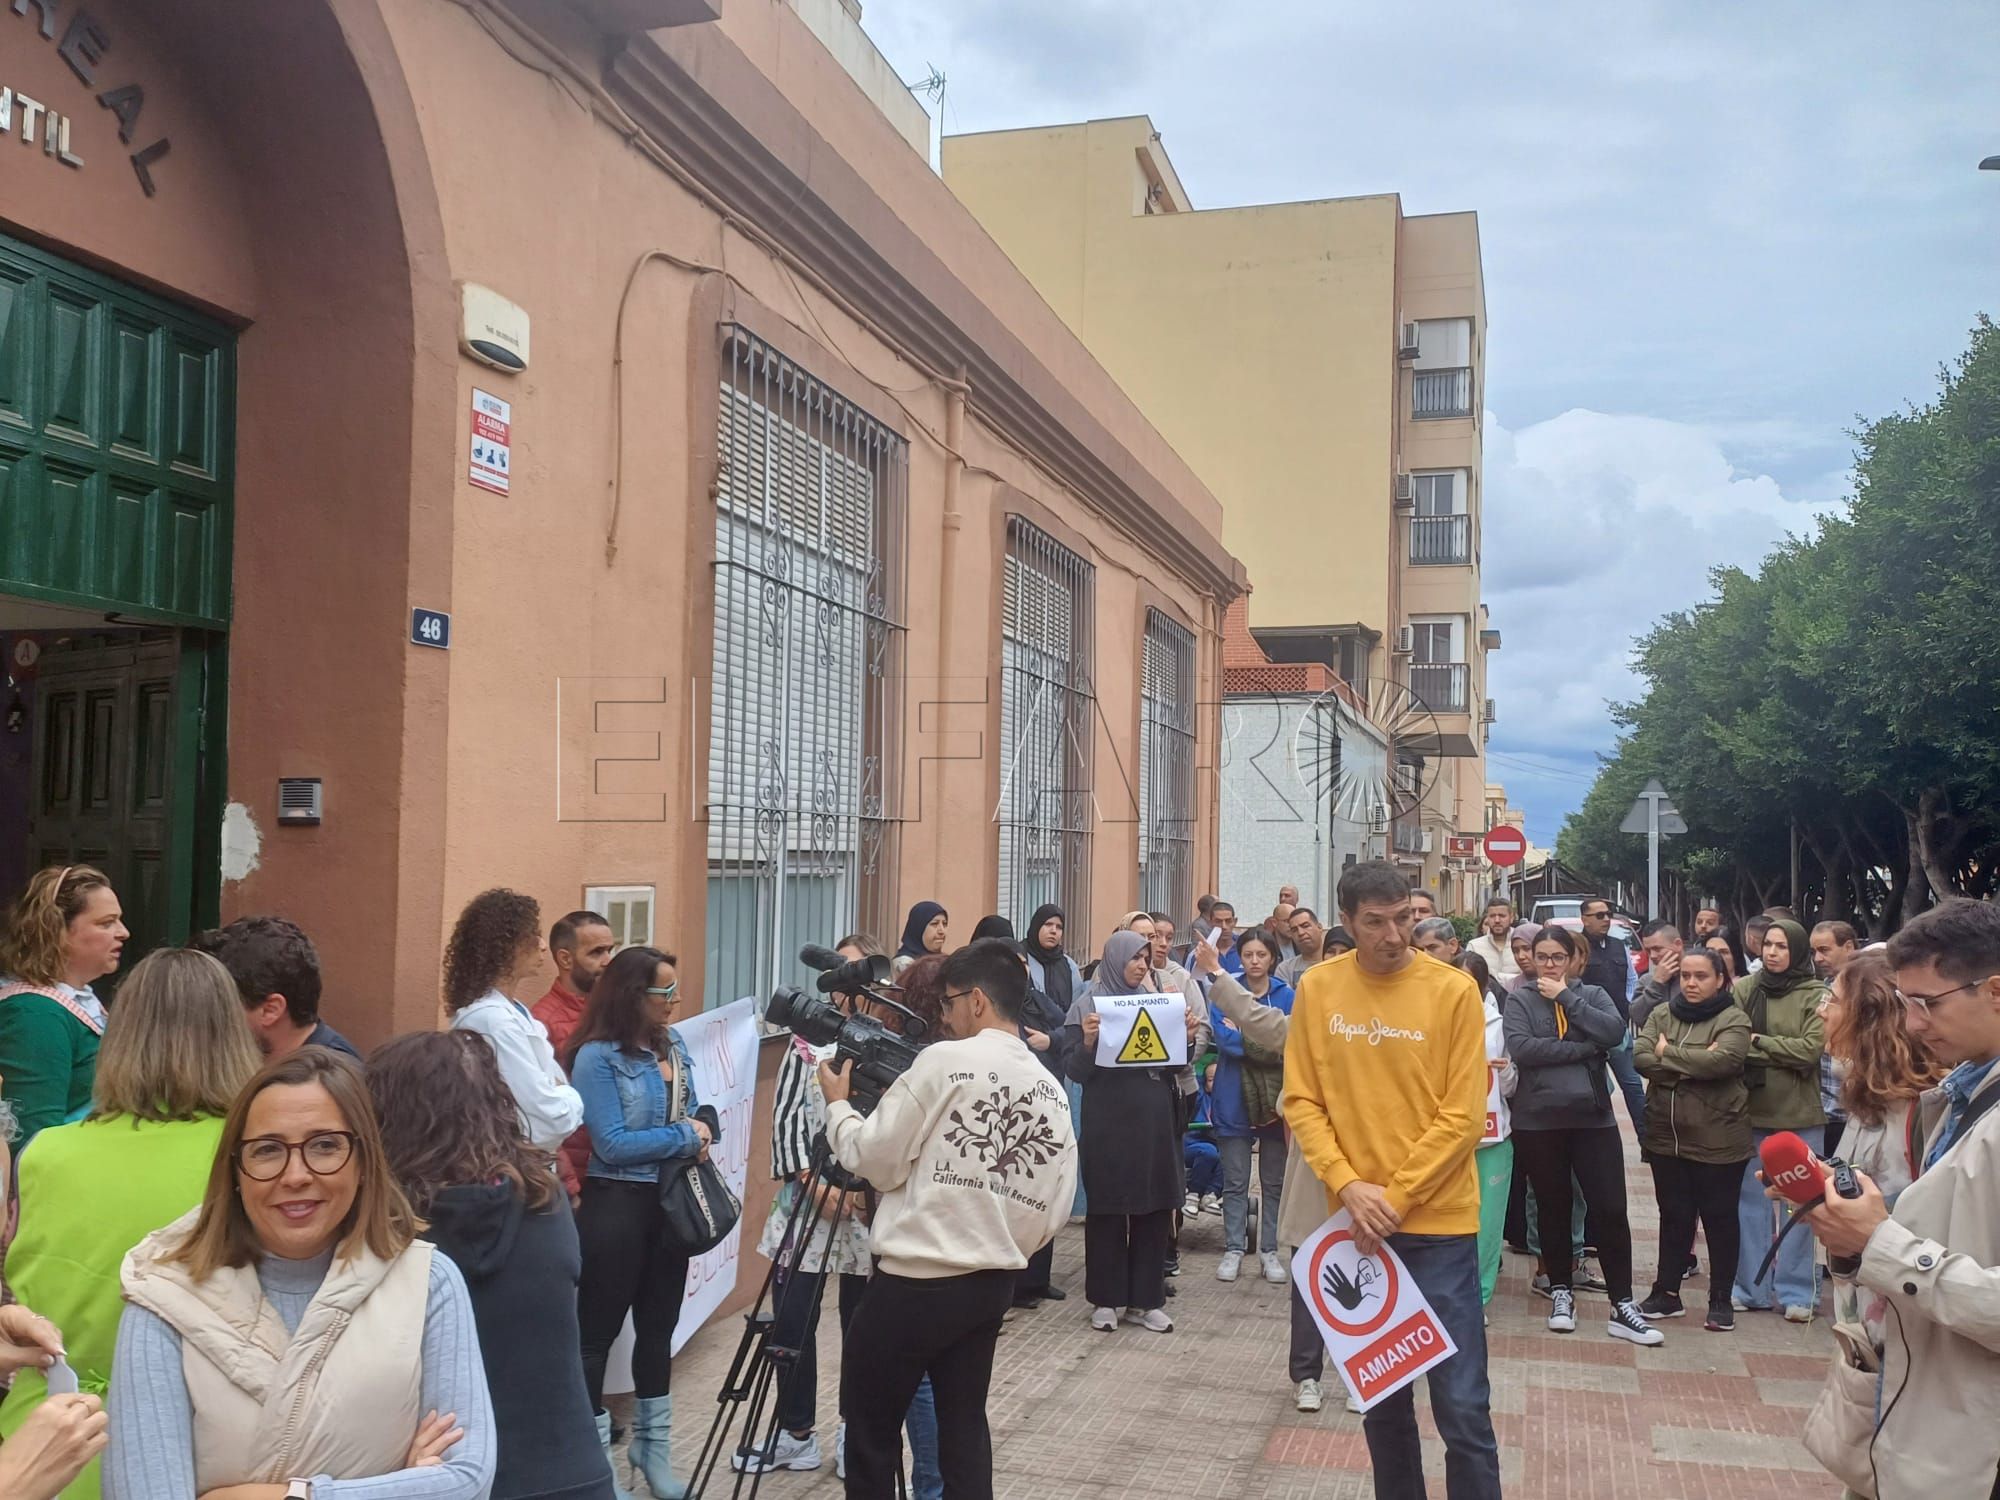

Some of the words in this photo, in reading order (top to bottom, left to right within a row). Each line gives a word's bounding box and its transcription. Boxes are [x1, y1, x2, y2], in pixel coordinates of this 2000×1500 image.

[477, 414, 505, 433] ALARMA
[1137, 997, 1169, 1006] AMIANTO
[1329, 1013, 1368, 1042] Pepe
[1368, 1017, 1425, 1046] Jeans
[949, 1071, 975, 1083] Time
[935, 1159, 954, 1172] L.A.
[1774, 1164, 1811, 1187] rne
[933, 1172, 984, 1190] California
[1010, 1189, 1048, 1212] Records
[1358, 1325, 1434, 1388] AMIANTO
